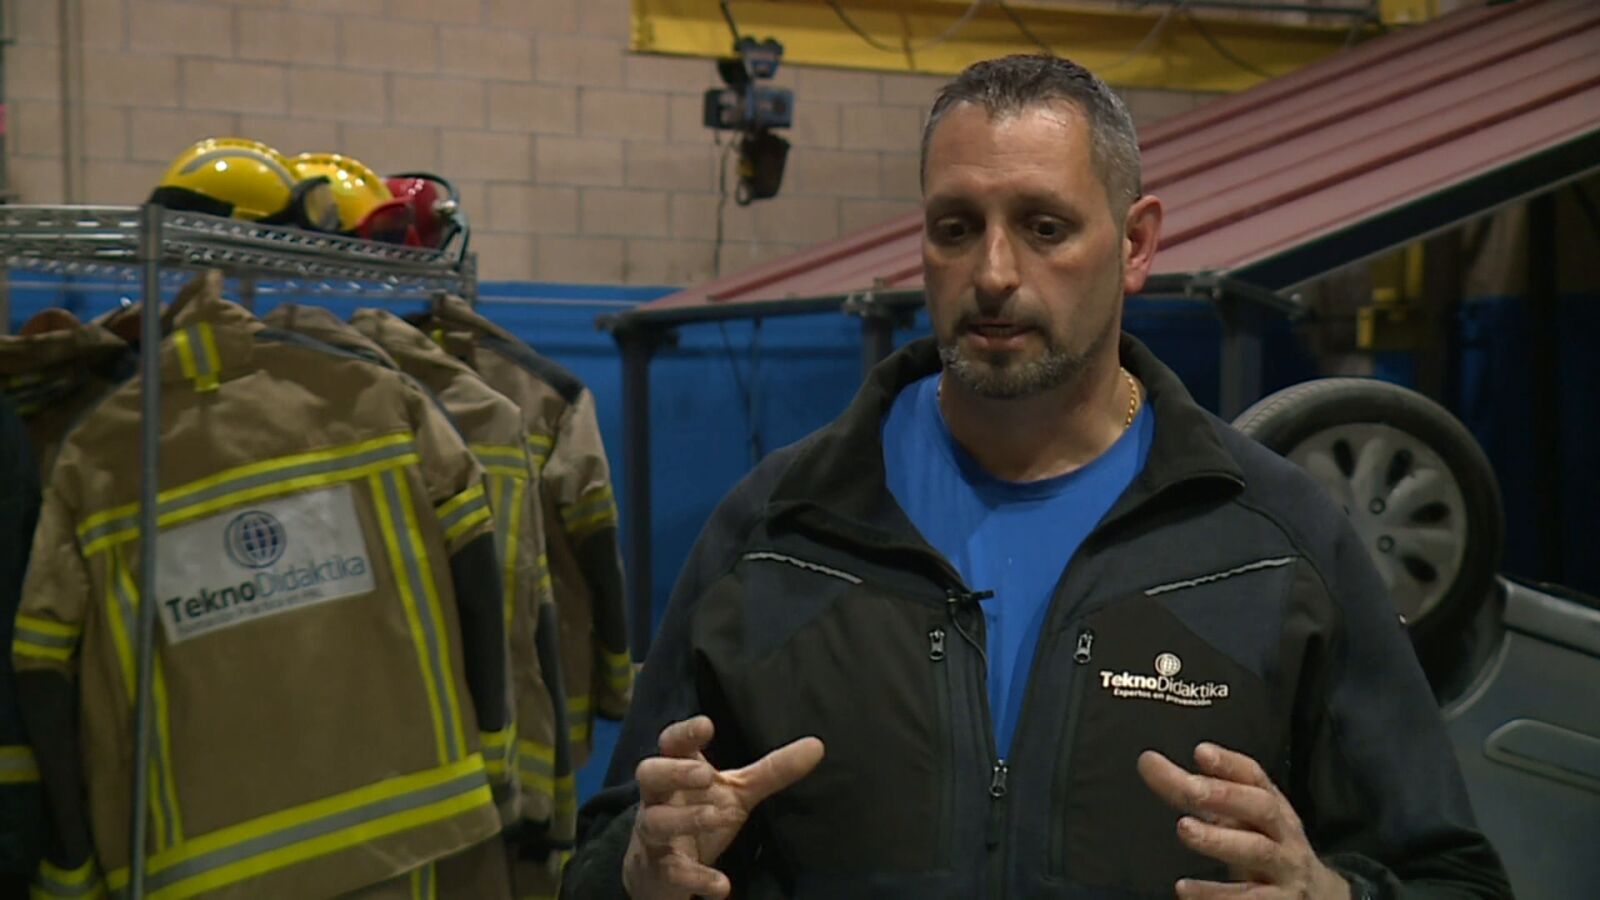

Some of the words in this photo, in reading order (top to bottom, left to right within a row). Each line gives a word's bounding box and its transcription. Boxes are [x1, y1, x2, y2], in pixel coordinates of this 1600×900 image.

[166, 554, 367, 623] TeknoDidaktika
[1100, 670, 1229, 698] TeknoDidaktika
[1113, 687, 1151, 698] Expertos
